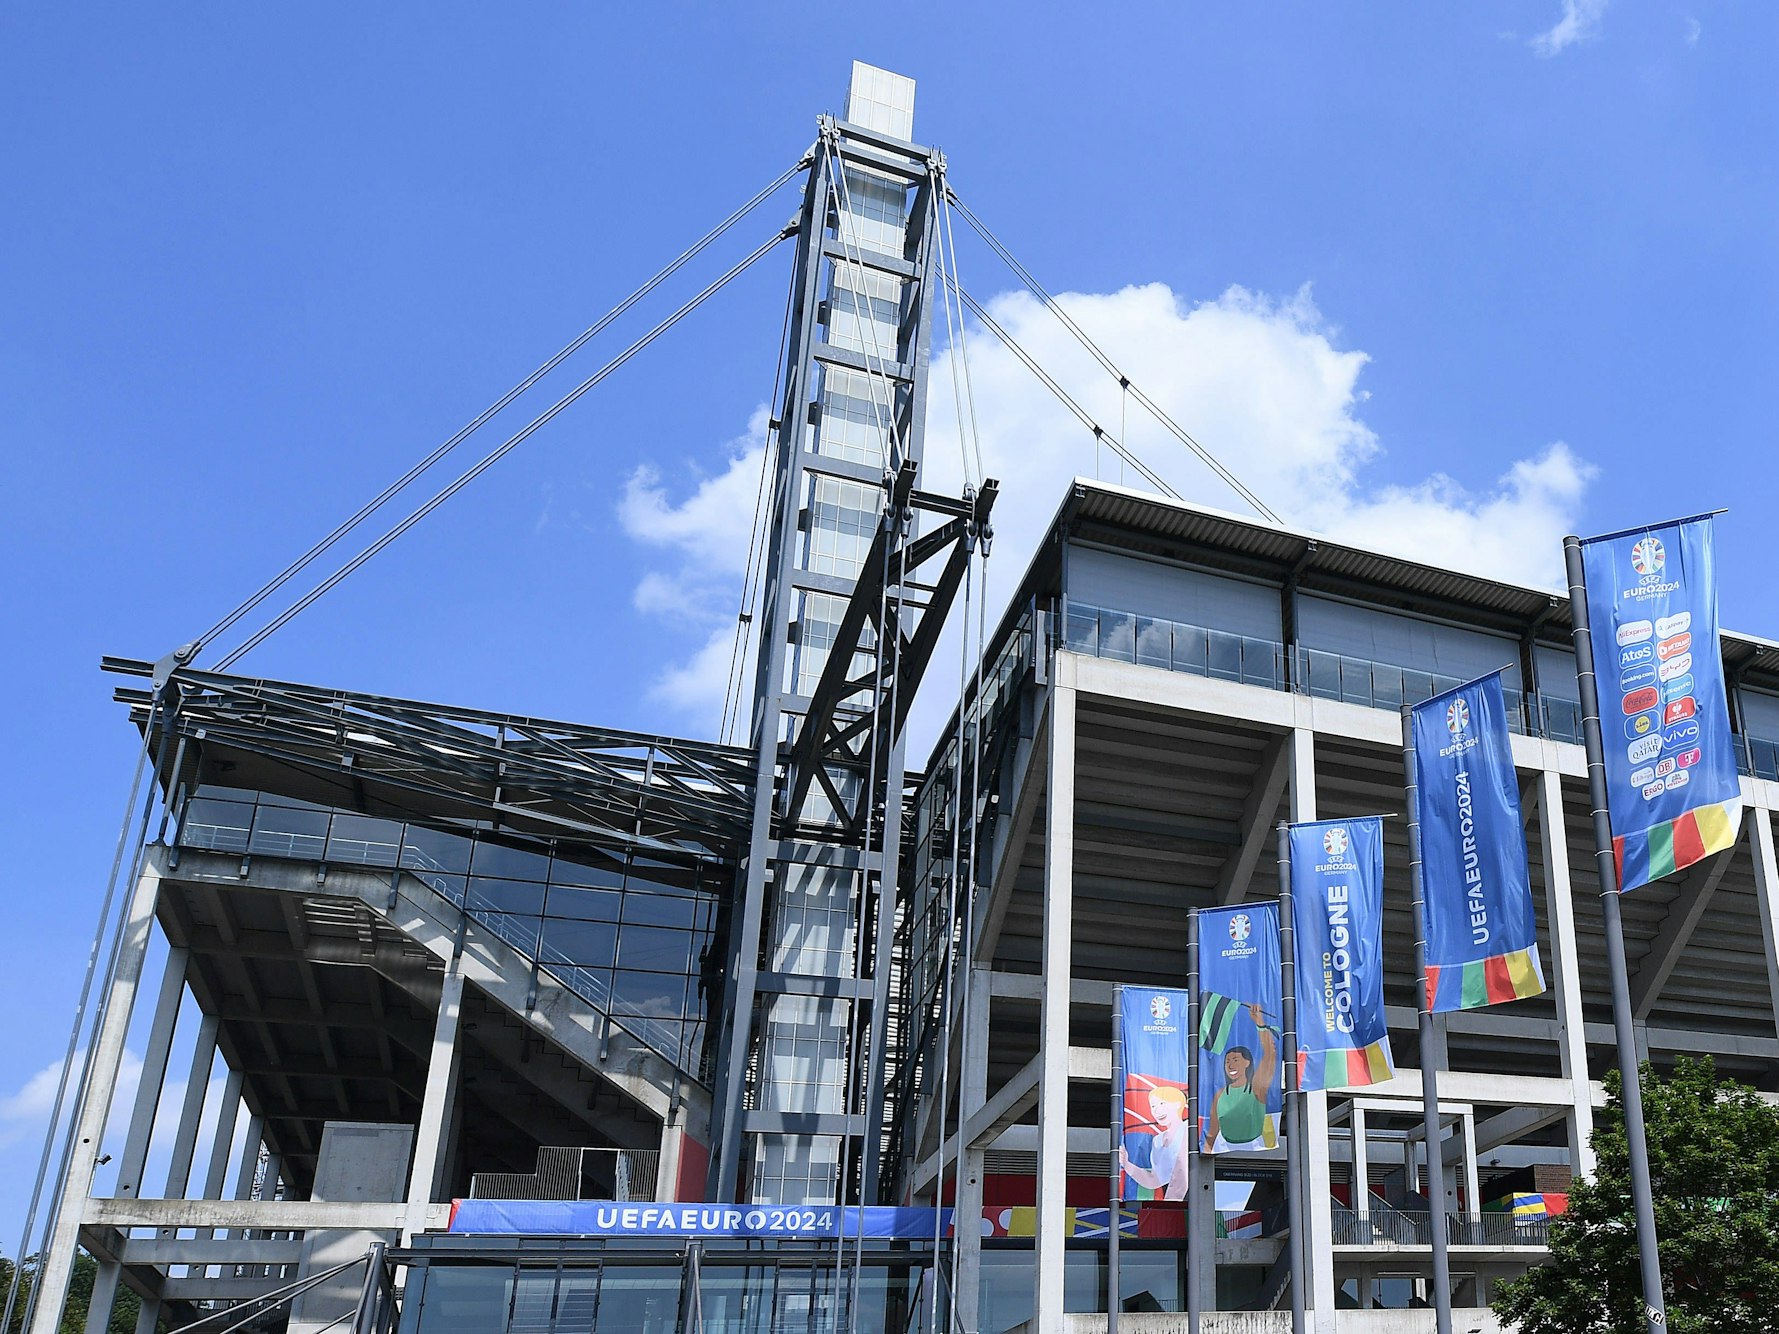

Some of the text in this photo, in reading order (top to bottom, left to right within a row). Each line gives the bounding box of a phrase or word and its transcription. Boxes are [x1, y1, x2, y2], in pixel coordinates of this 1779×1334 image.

[1623, 581, 1680, 599] EURO2024
[1636, 592, 1668, 602] GERMANY
[1663, 726, 1698, 743] vivo
[1439, 736, 1479, 757] EURO2024
[1639, 738, 1658, 750] visit
[1632, 744, 1659, 760] QATAR
[1658, 762, 1671, 773] DB
[1643, 783, 1663, 797] ERGO
[1315, 862, 1357, 872] EURO2024
[1221, 947, 1257, 957] EURO2024
[1328, 885, 1355, 1034] COLOGNE
[1322, 952, 1336, 1033] WELCOME TO
[1143, 1025, 1177, 1033] EURO2024
